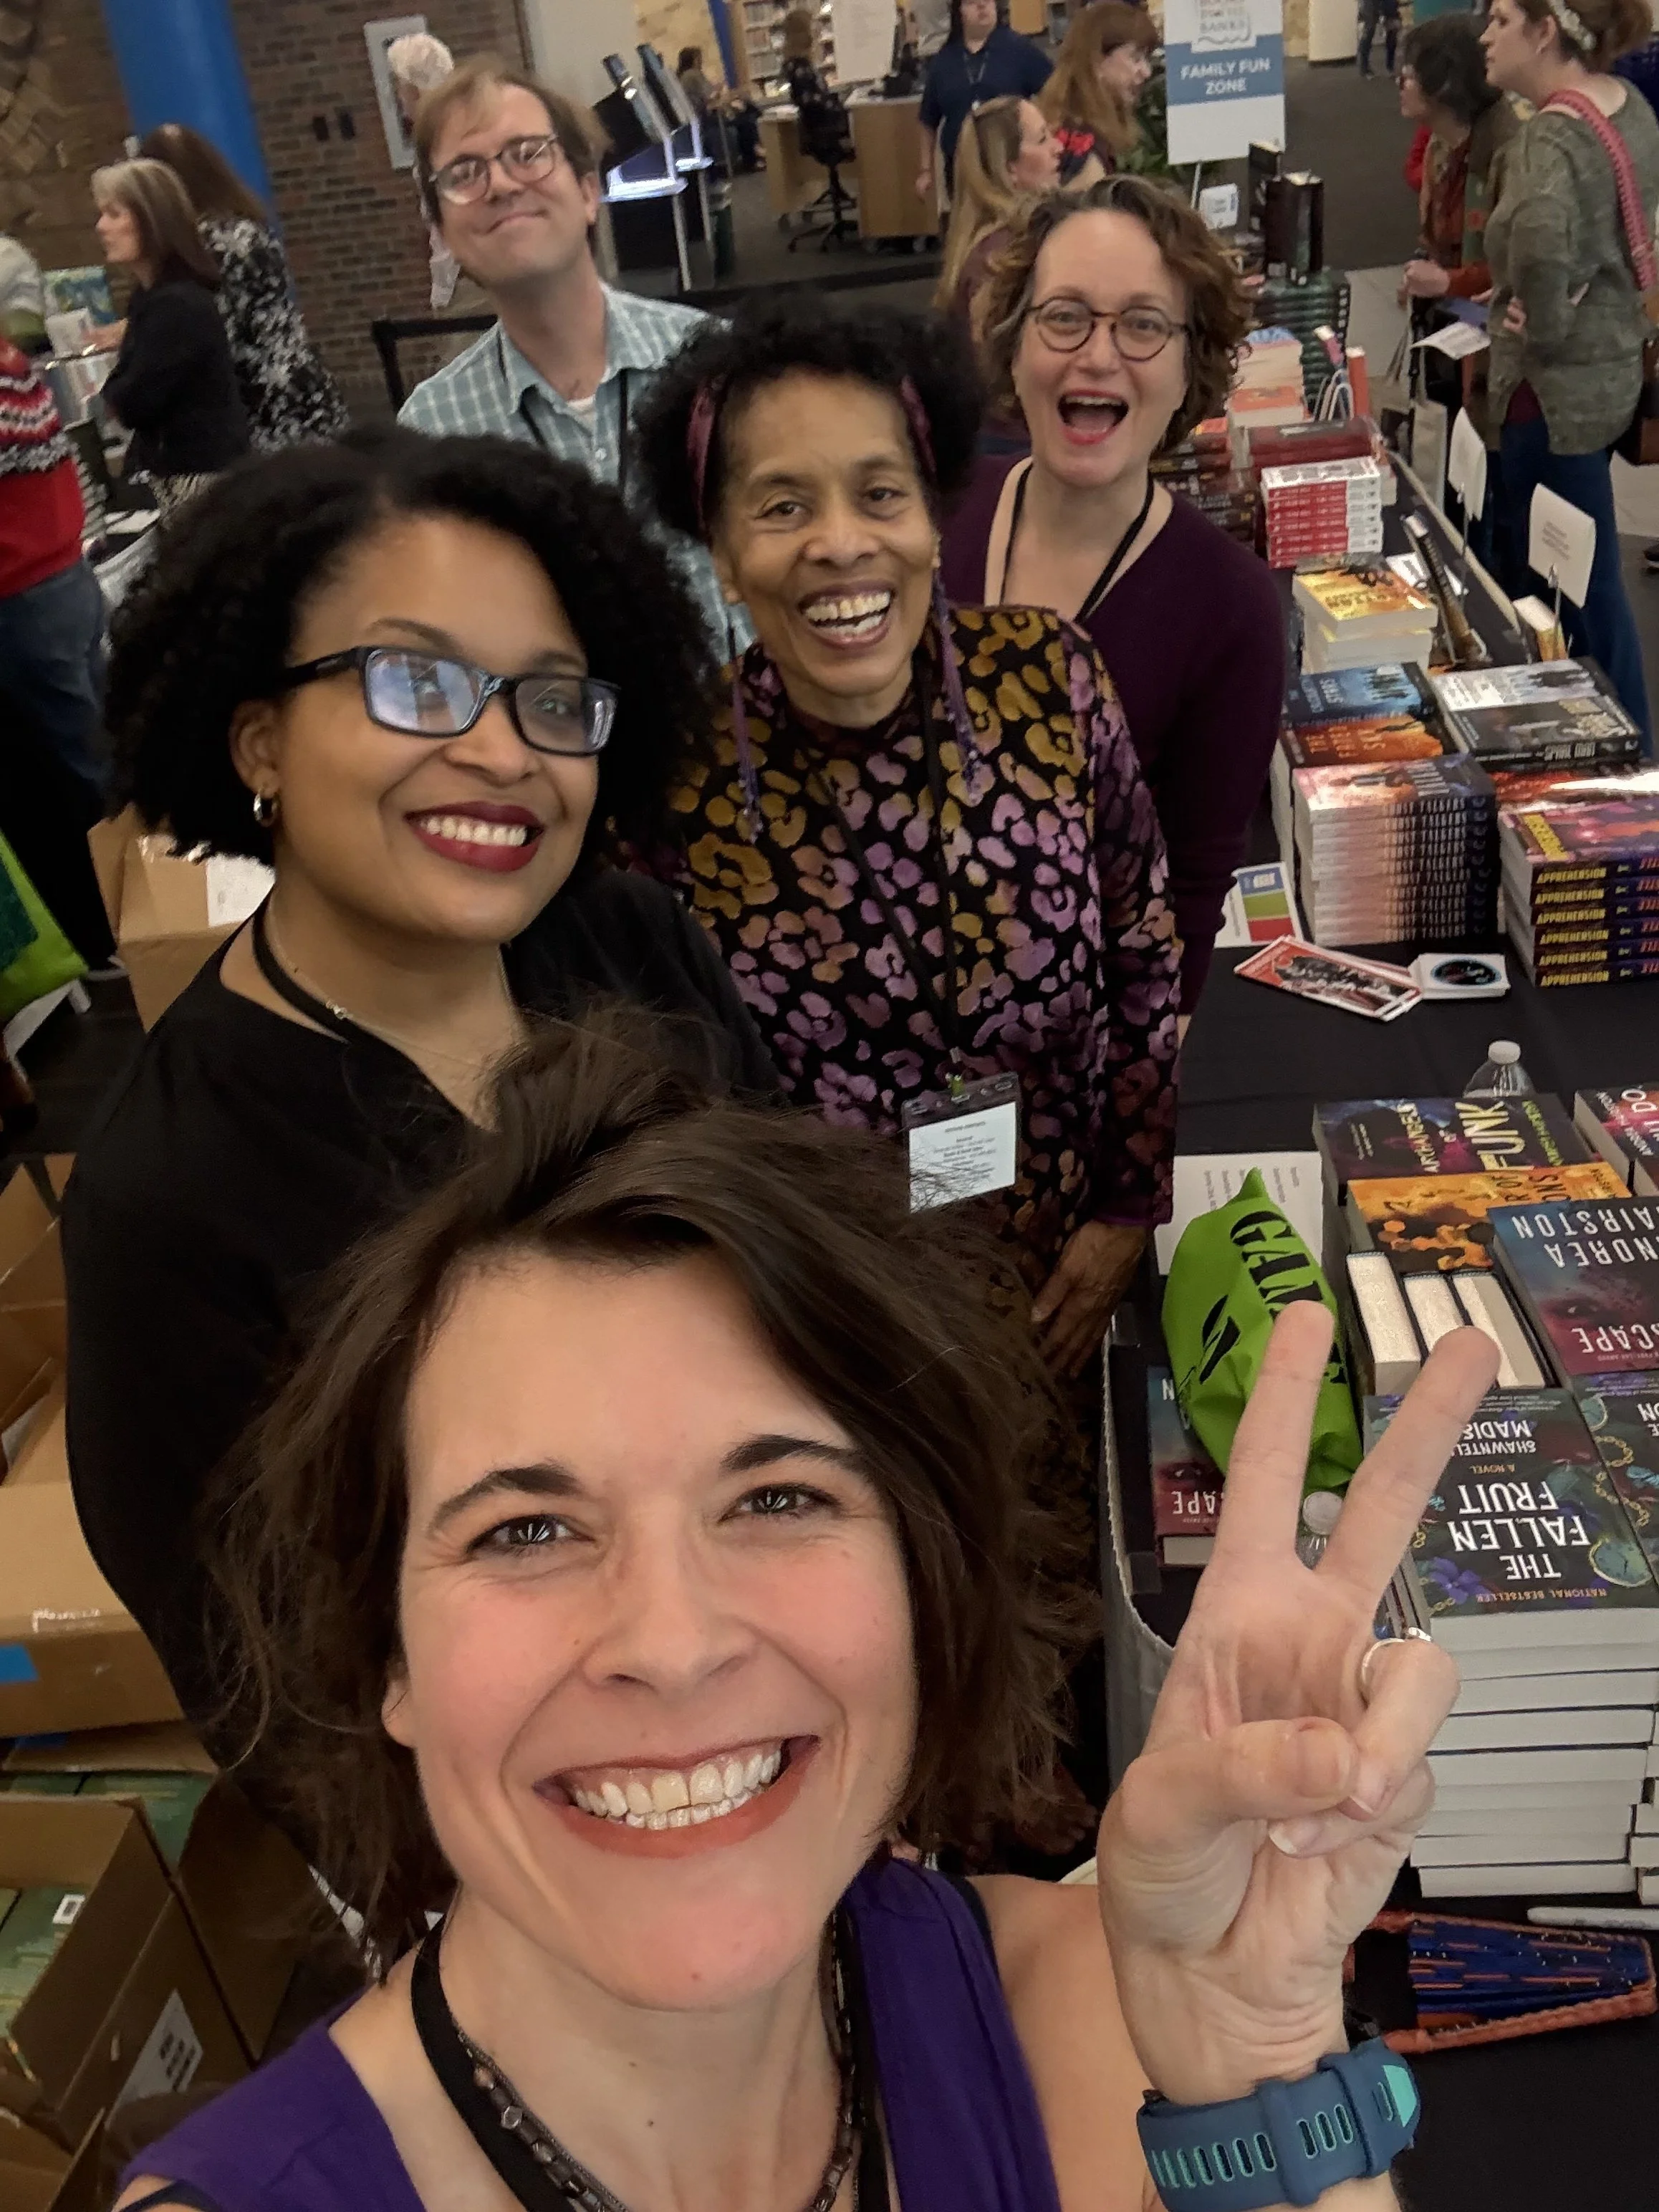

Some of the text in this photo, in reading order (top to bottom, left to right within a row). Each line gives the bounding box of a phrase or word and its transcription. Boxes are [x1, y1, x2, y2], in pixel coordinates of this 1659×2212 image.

[1180, 57, 1271, 81] FAMILY FUN
[1205, 77, 1246, 95] ZONE
[1455, 1100, 1536, 1171] FUNK
[1511, 1206, 1659, 1239] AIRSTON
[1544, 1236, 1659, 1268] NDREA
[1463, 1420, 1532, 1440] MADIS
[1452, 1440, 1537, 1457] SHAWNTEL
[1171, 1491, 1218, 1515] APE
[1458, 1481, 1559, 1514] FRUIT
[1447, 1515, 1592, 1552] FALLEN
[1499, 1553, 1562, 1580] THE
[1476, 1587, 1607, 1602] NATIONAL BESTSELLER
